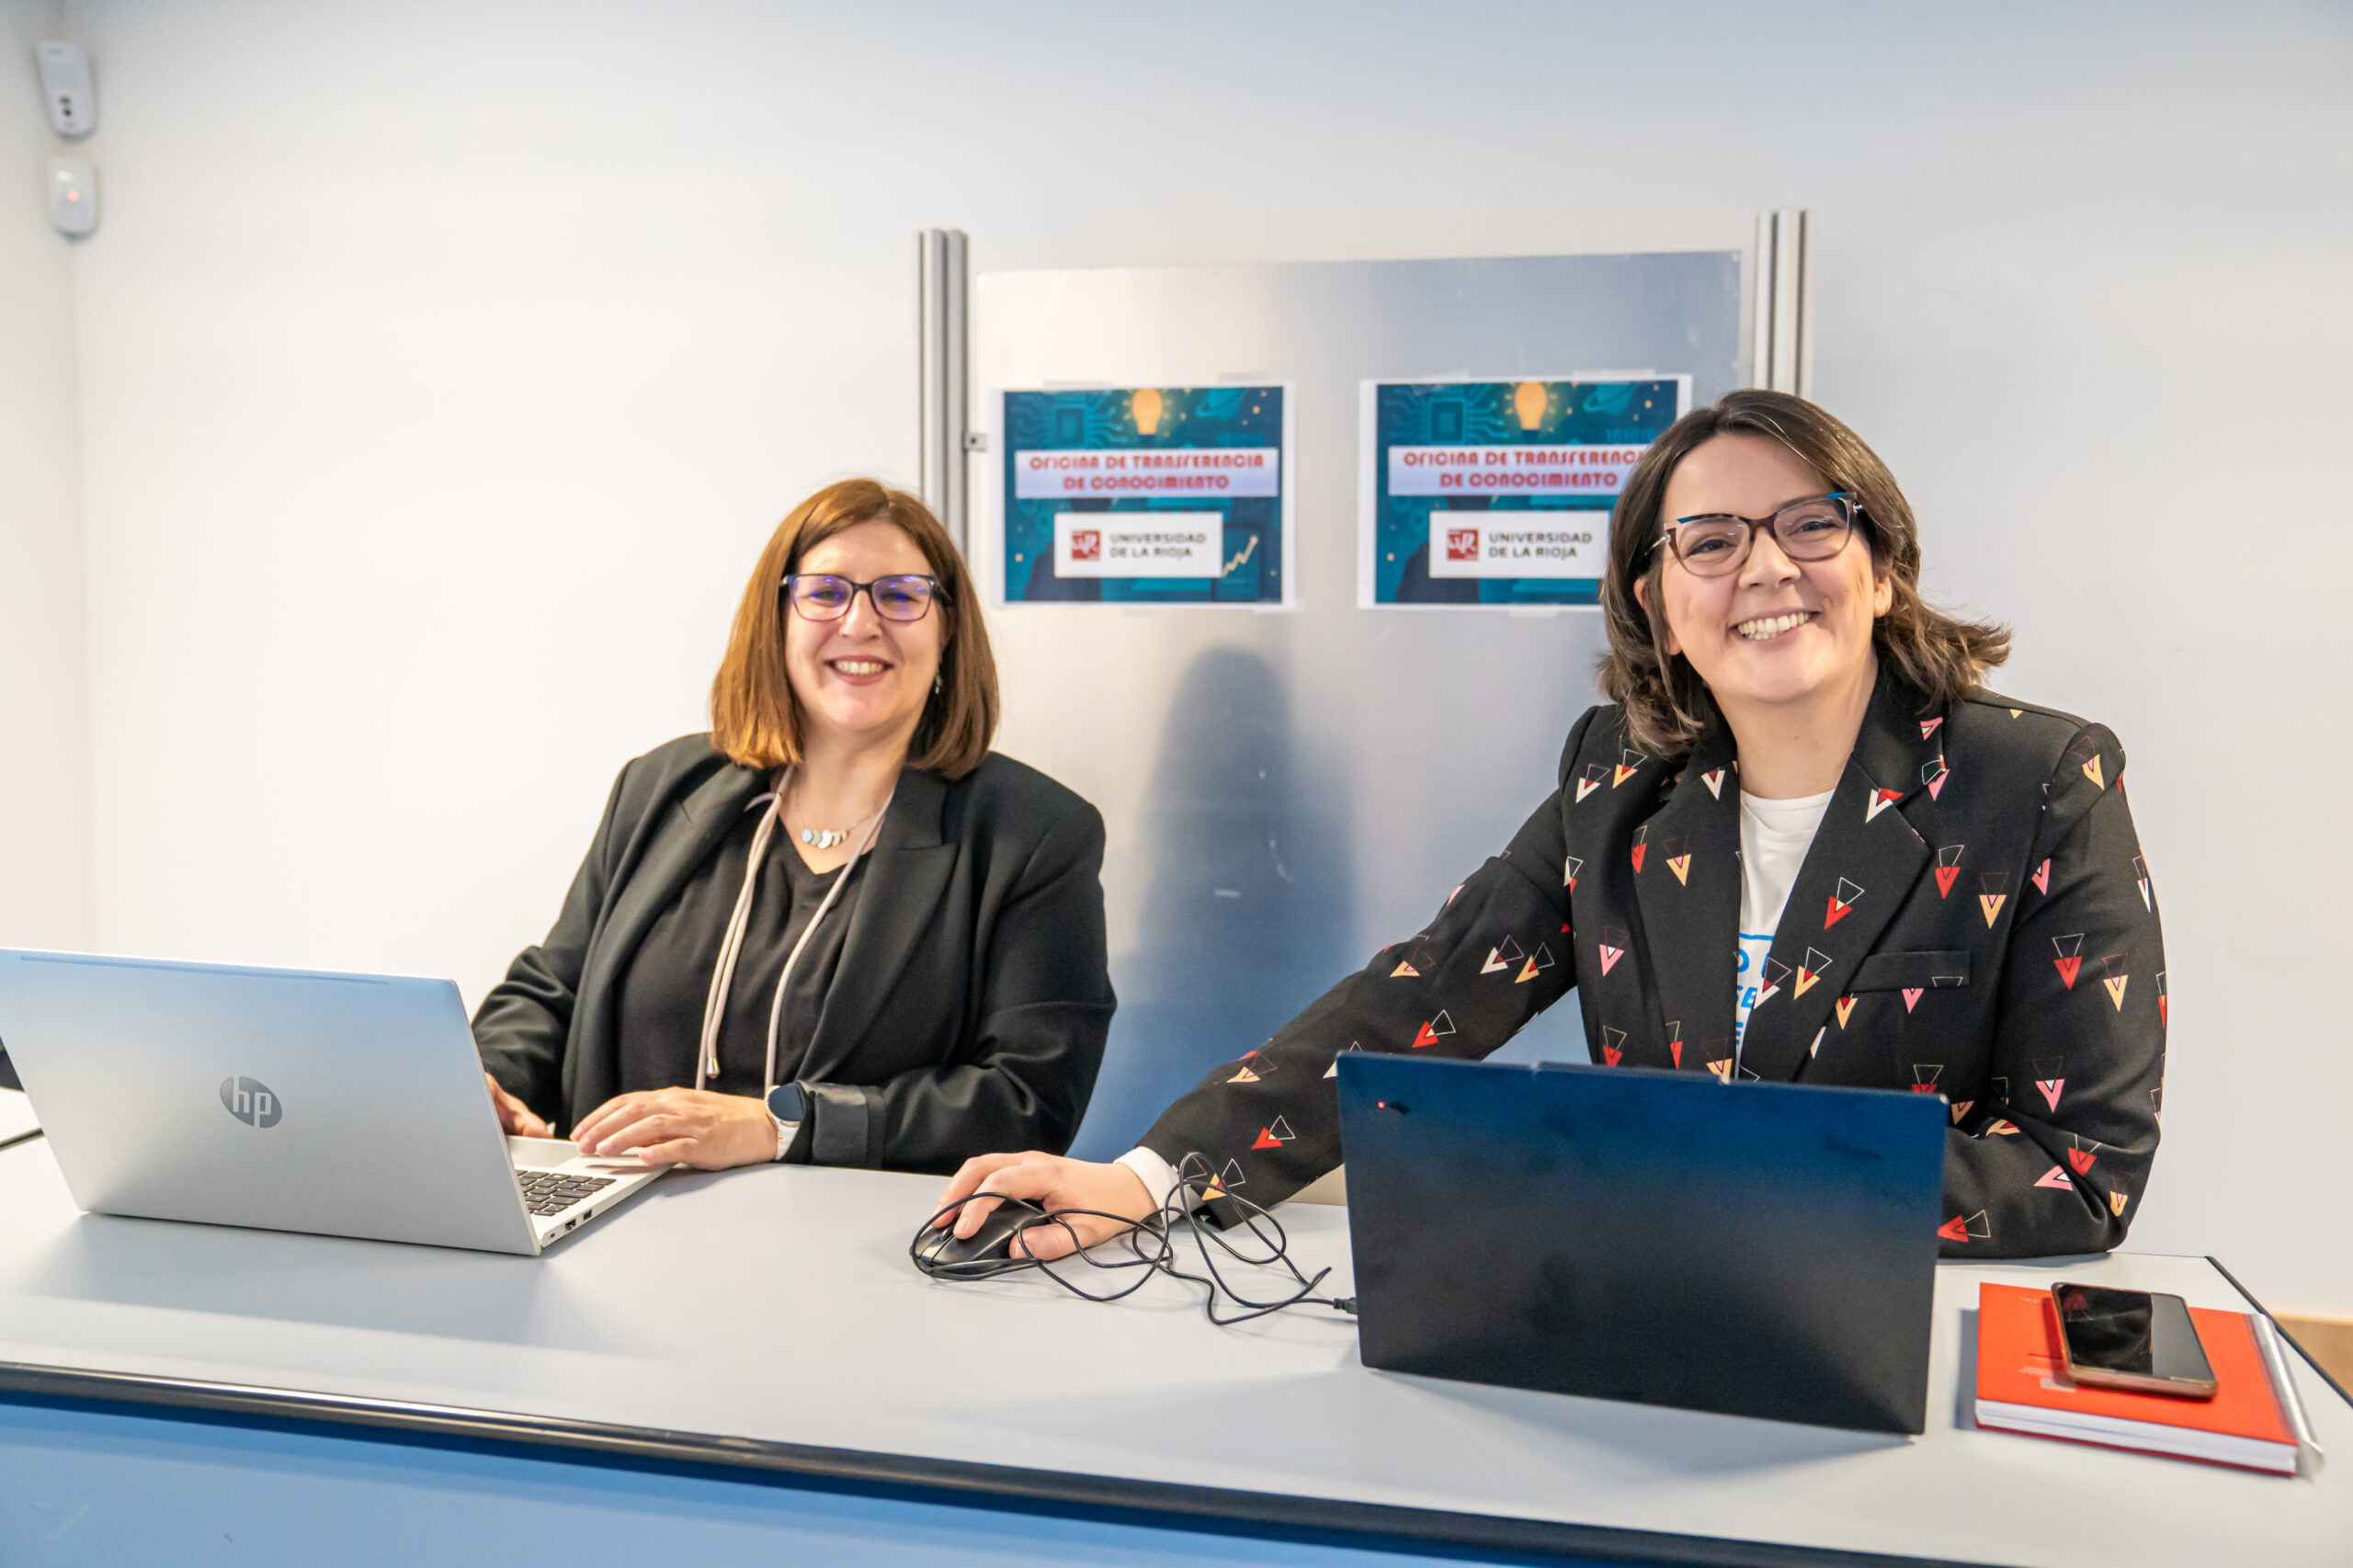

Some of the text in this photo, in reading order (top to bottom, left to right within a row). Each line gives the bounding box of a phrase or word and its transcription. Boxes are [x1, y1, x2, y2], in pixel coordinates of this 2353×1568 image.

[1029, 453, 1264, 471] OFICINA DE TRANSFERENCIA
[1404, 450, 1644, 467] OFICINA DE TRANSFERENC
[1063, 474, 1230, 491] DE CONOCIMIENTO
[1439, 472, 1618, 488] DE CONOCIMIENTO
[1109, 532, 1206, 545] UNIVERSIDAD
[1488, 532, 1593, 545] UNIVERSIDAD
[1109, 546, 1192, 561] DE LA RIOJA
[1489, 546, 1576, 561] DE LA RIOJA
[232, 1075, 273, 1129] hp
